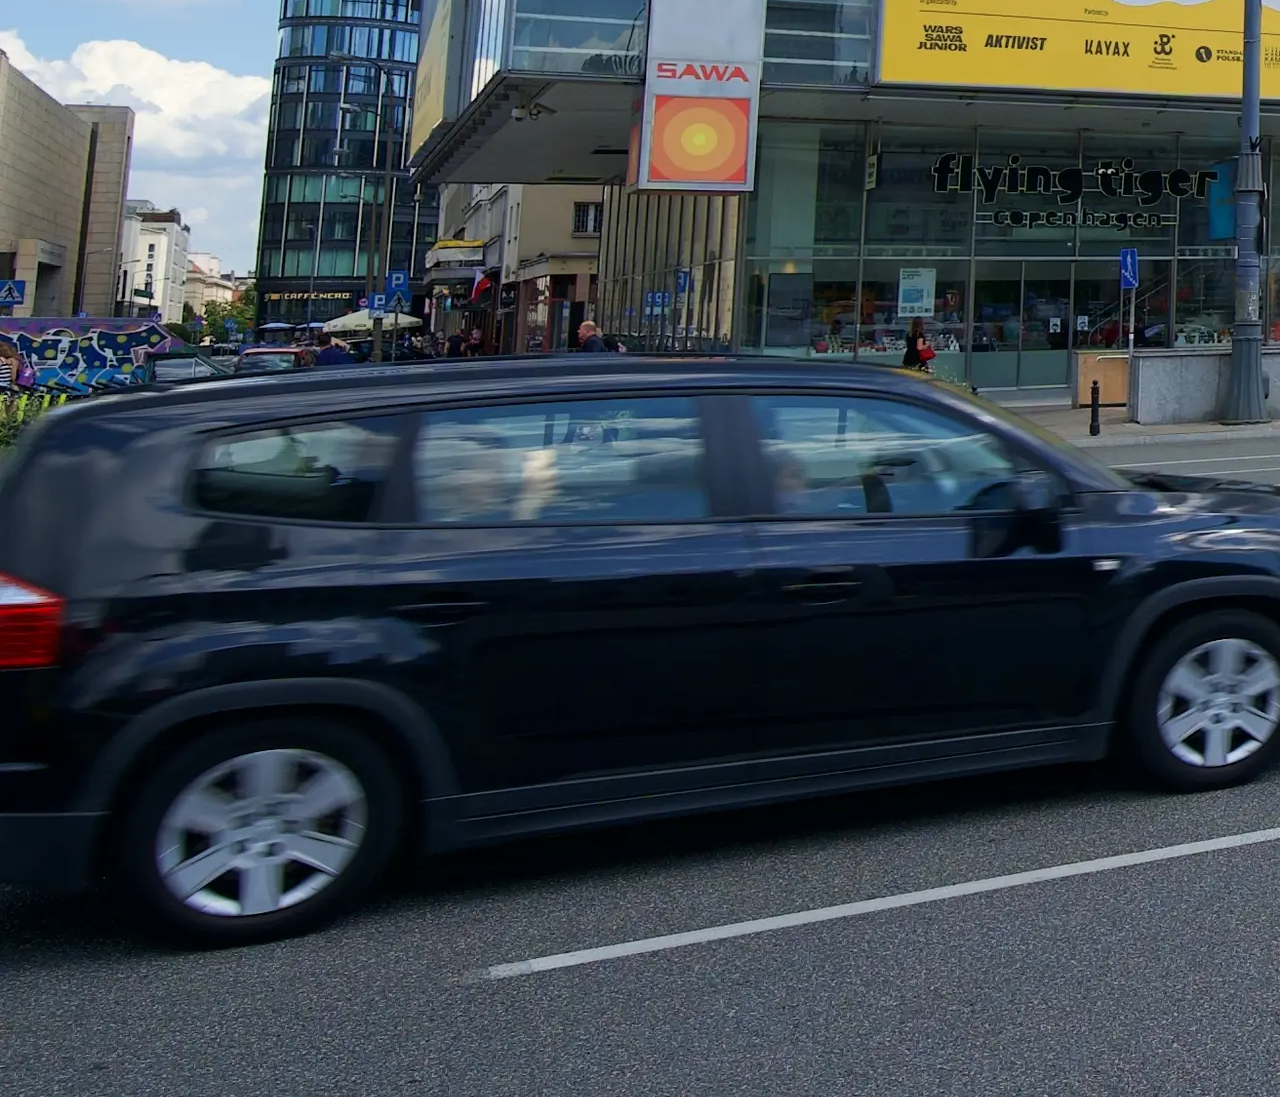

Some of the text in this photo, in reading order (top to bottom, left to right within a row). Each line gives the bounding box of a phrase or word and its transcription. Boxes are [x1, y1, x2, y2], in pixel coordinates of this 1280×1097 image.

[923, 24, 964, 35] WARS
[924, 33, 963, 43] SAWA
[984, 34, 1048, 51] AKTIVIST
[917, 41, 968, 52] JUNIOR
[656, 62, 750, 83] SAWA
[932, 152, 1083, 204] flying
[1097, 156, 1219, 206] tiger
[991, 208, 1164, 232] copenhagen
[391, 273, 404, 288] P
[319, 292, 350, 300] NERO
[374, 294, 386, 308] P
